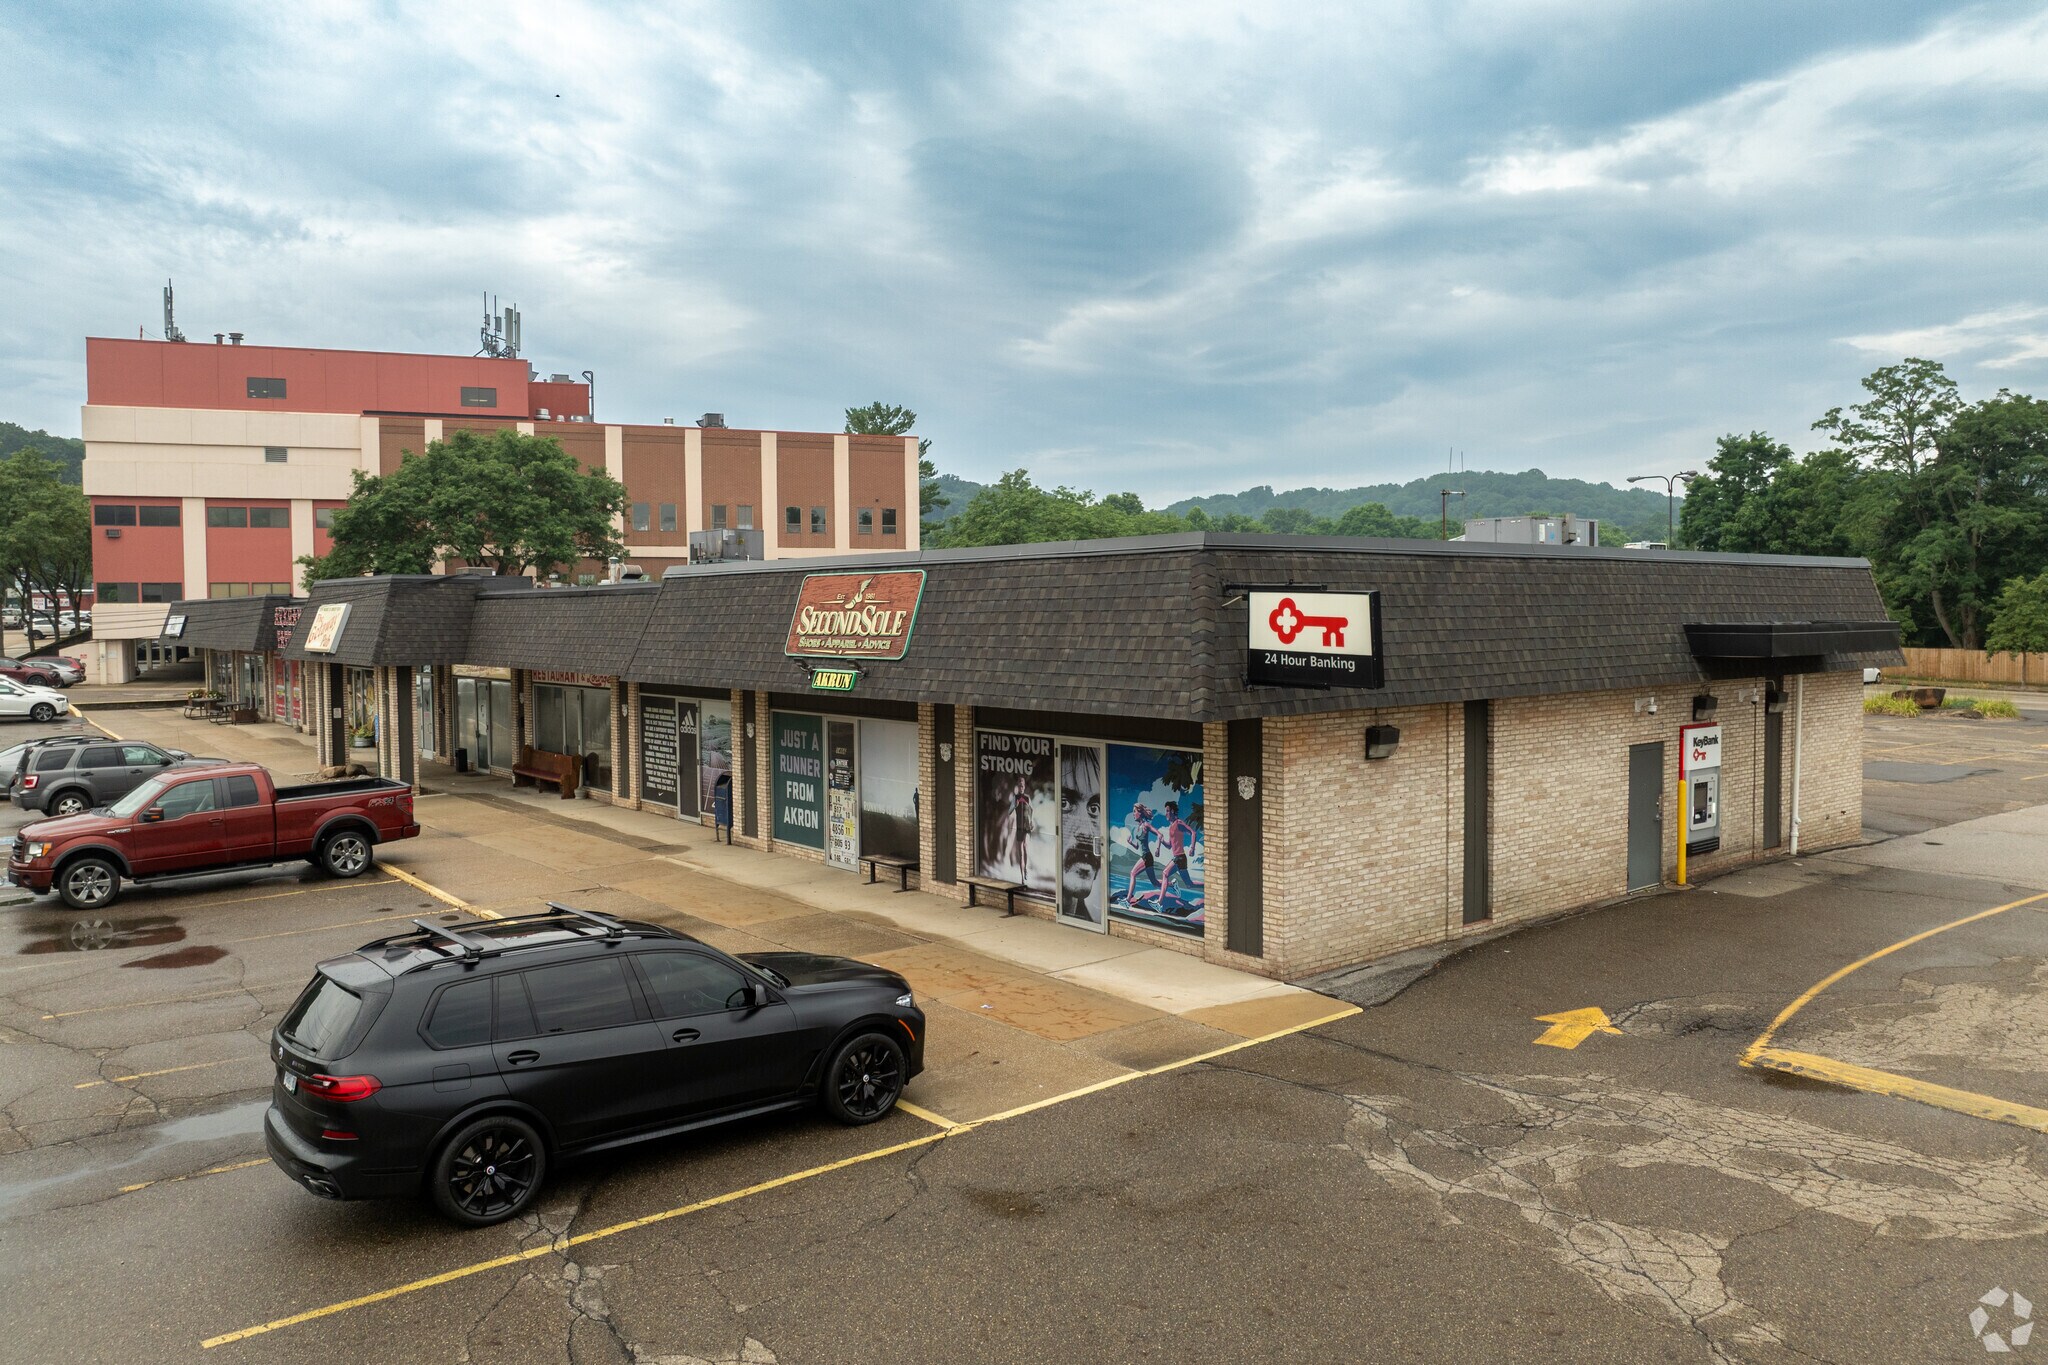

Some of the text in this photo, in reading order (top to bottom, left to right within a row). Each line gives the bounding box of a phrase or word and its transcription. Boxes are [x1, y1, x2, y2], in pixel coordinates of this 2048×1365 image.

[861, 638, 891, 650] ADVICE
[1265, 653, 1355, 672] 24 Hour Banking
[532, 670, 579, 683] RESTAURANT
[814, 672, 852, 688] AKRUN
[680, 726, 697, 734] adidas
[781, 729, 819, 751] JUST A
[981, 734, 1050, 756] FIND YOUR
[1693, 734, 1719, 748] KeyBank
[780, 754, 820, 777] RUNNER
[981, 755, 1033, 775] STRONG
[786, 780, 814, 802] FROM
[783, 806, 818, 829] AKRON
